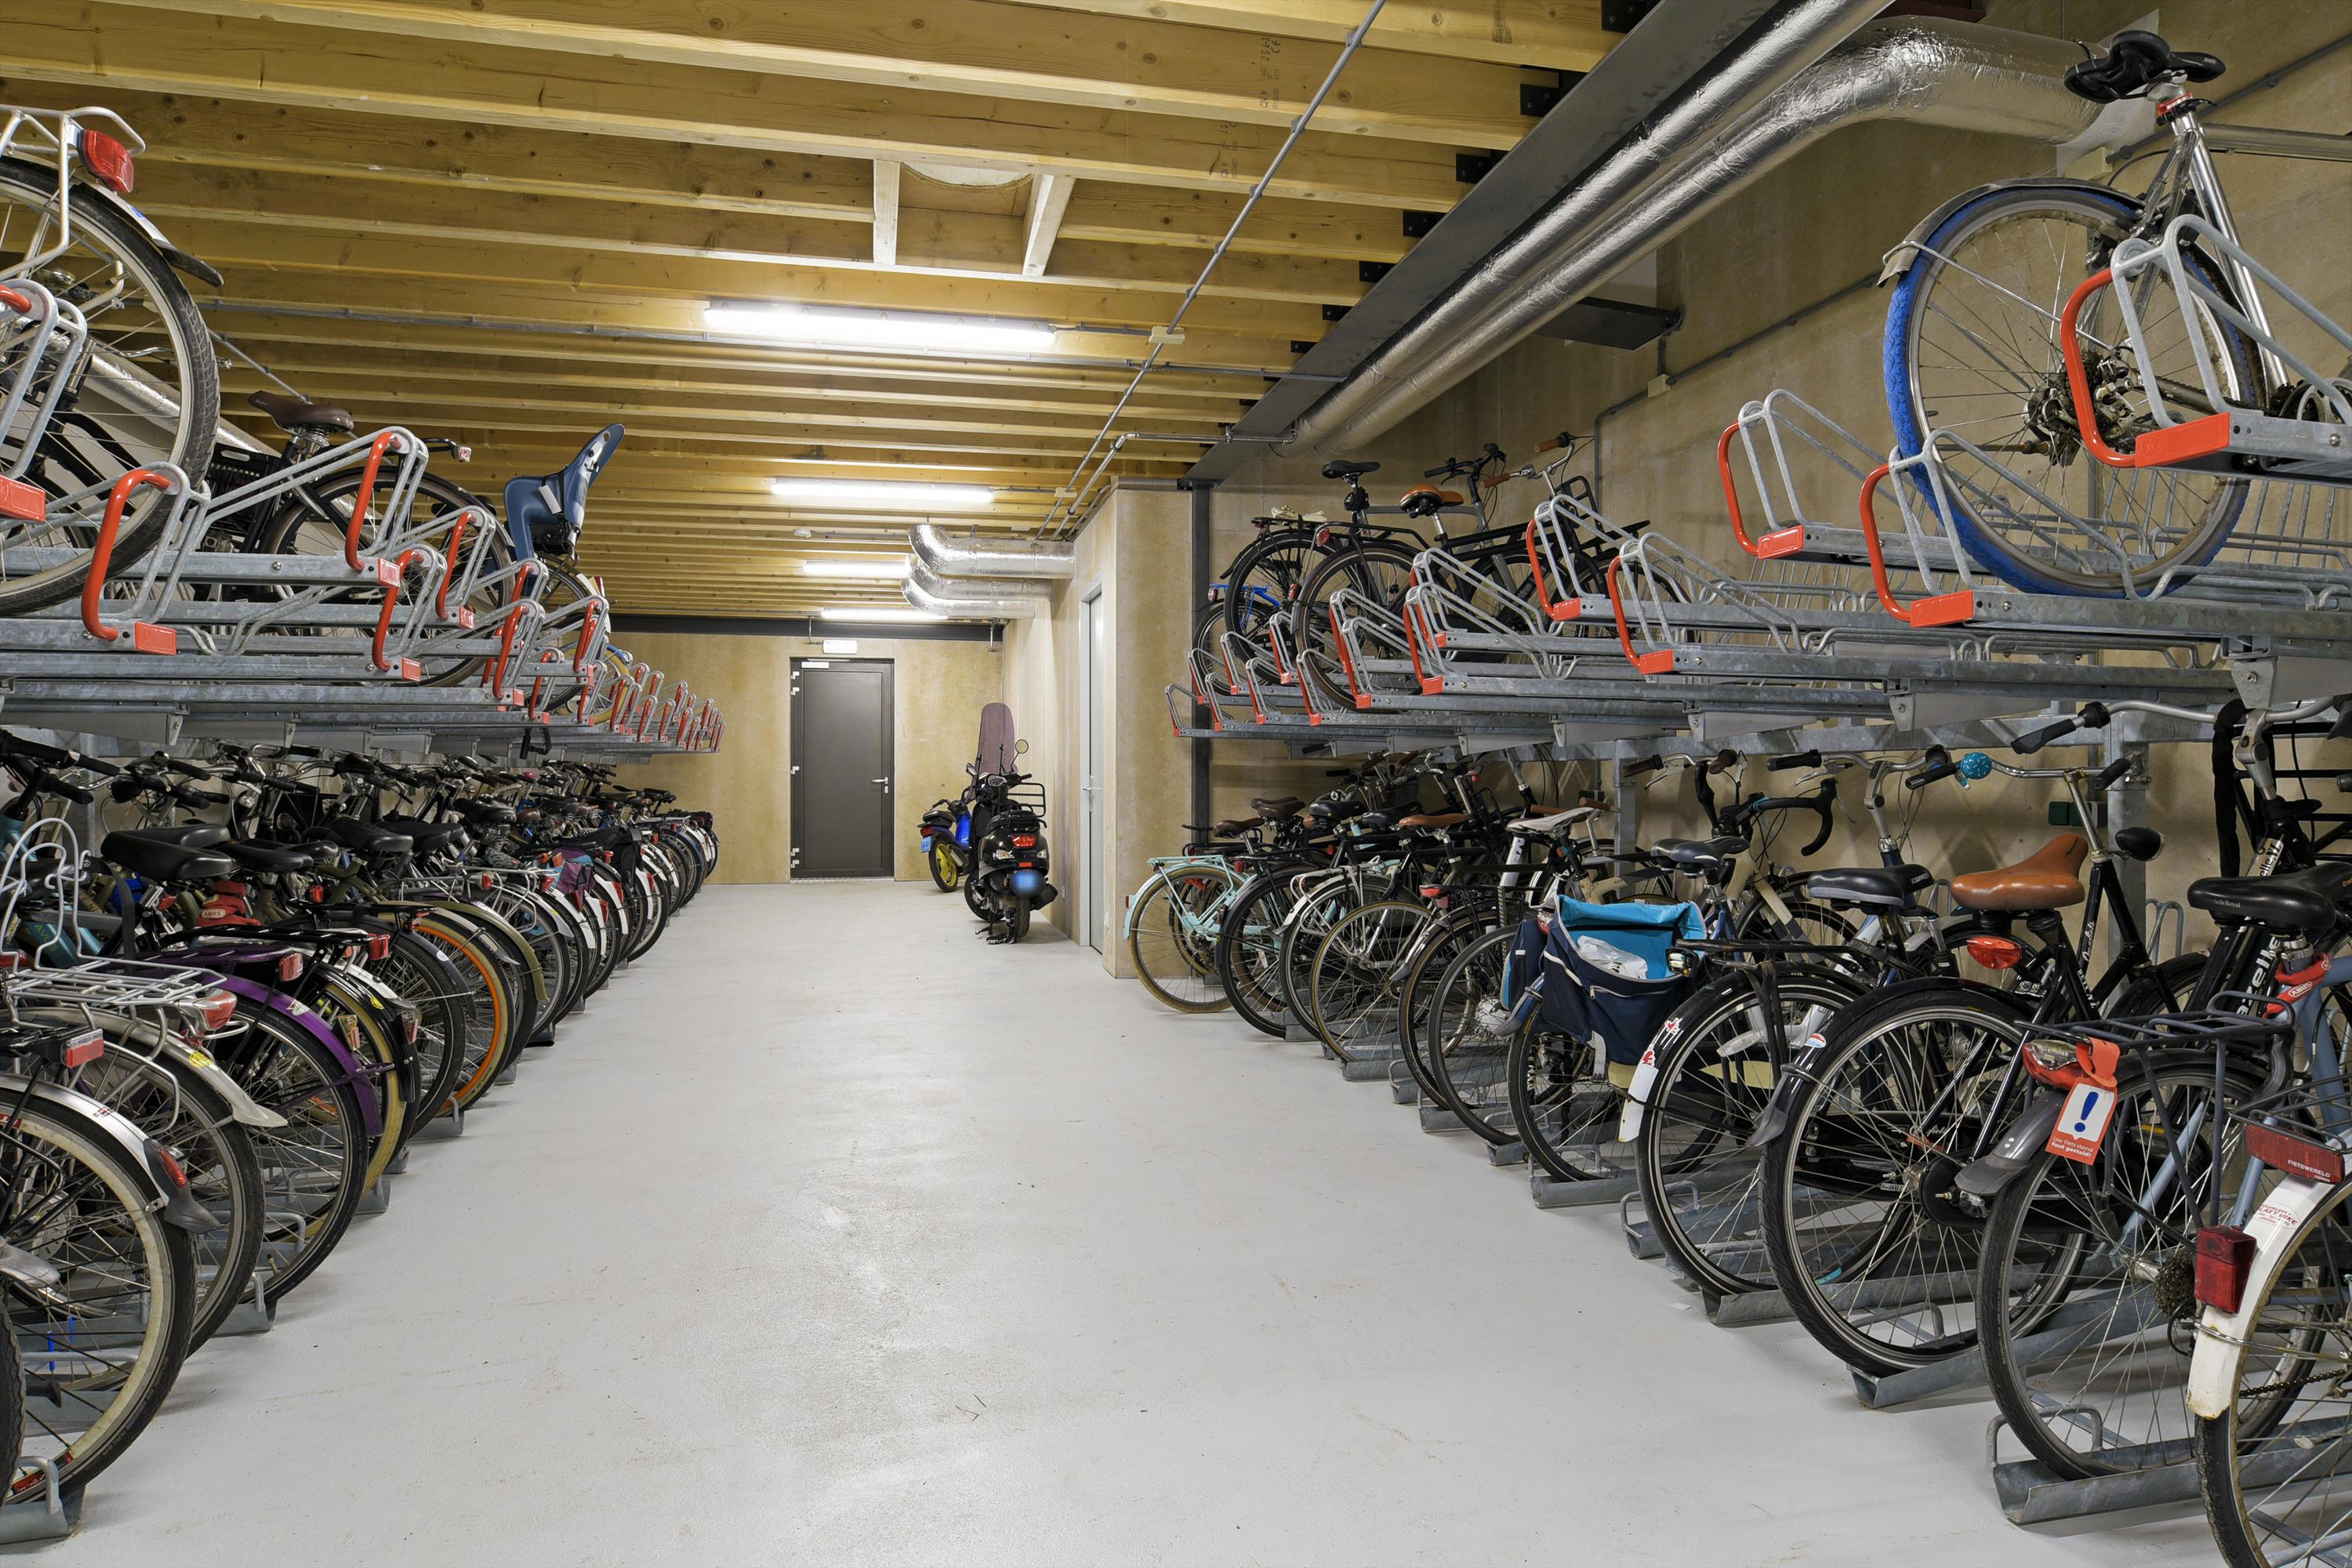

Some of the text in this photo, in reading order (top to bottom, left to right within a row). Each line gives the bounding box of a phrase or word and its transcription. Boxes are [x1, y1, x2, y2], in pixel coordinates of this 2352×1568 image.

[2236, 936, 2281, 1016] azelle
[2051, 1141, 2092, 1158] fout gestald!
[2077, 1143, 2094, 1153] stond
[2288, 1160, 2331, 1178] FIETSWERELD
